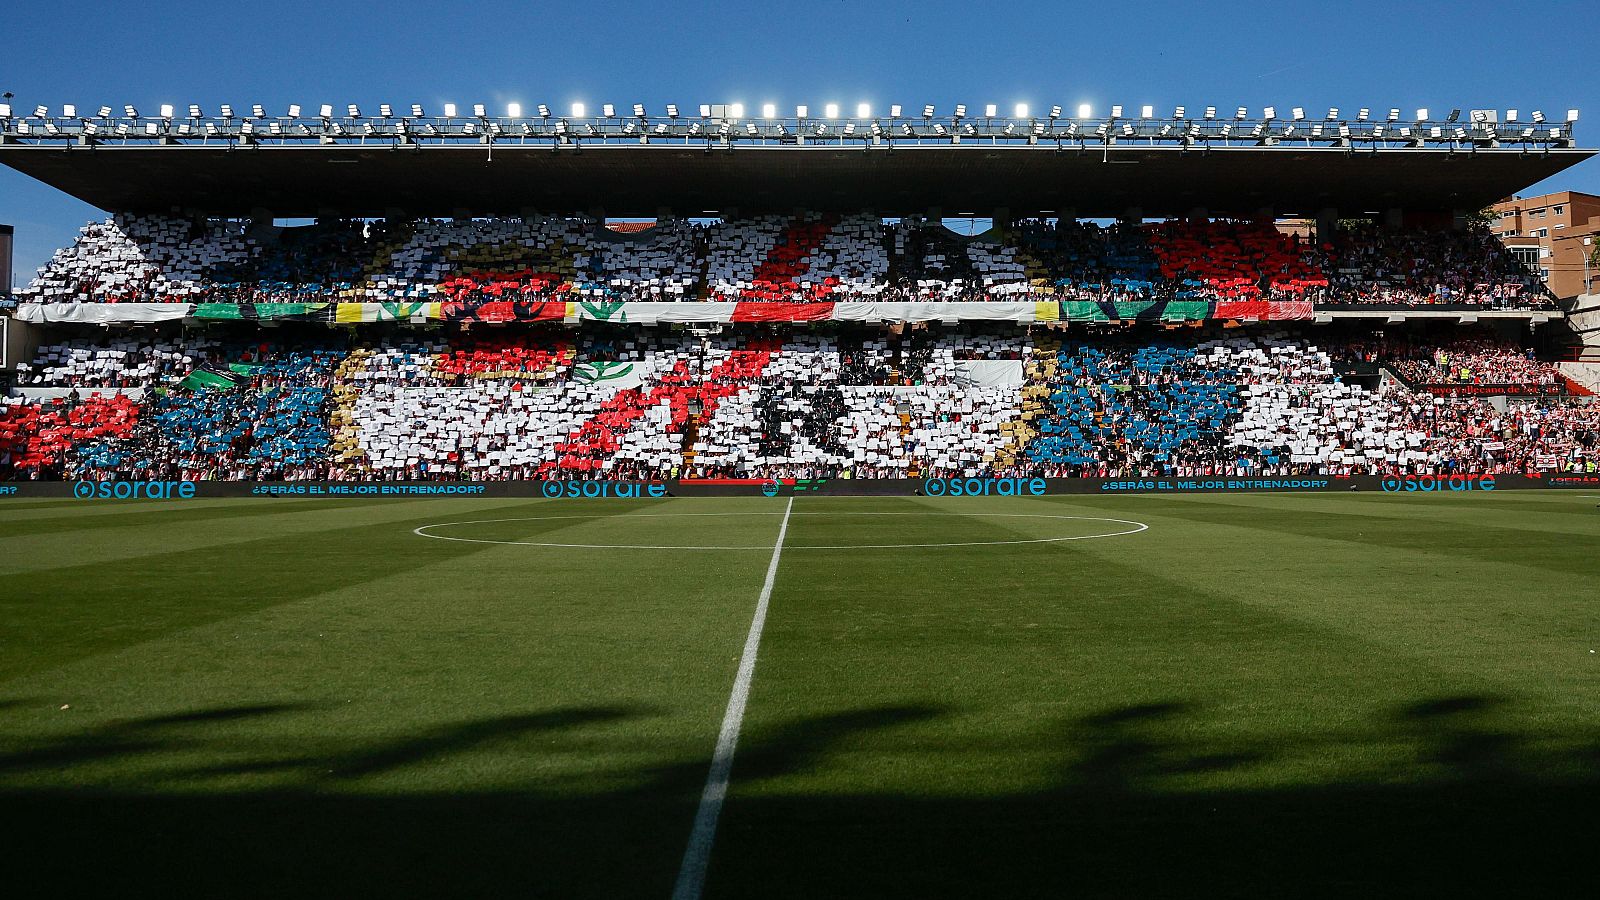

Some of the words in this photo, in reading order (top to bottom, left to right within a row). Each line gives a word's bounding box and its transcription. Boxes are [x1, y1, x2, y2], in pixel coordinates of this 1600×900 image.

[1455, 385, 1505, 393] Vallecano
[1507, 385, 1519, 393] de
[99, 481, 195, 498] sorare
[252, 484, 305, 493] ¿SERÁS
[309, 486, 325, 494] EL
[381, 486, 484, 494] ENTRENADOR?
[567, 480, 666, 497] sorare
[950, 478, 1047, 495] sorare
[1102, 480, 1154, 490] ¿SERÁS
[1177, 481, 1224, 489] MEJOR
[1405, 474, 1495, 491] sorare
